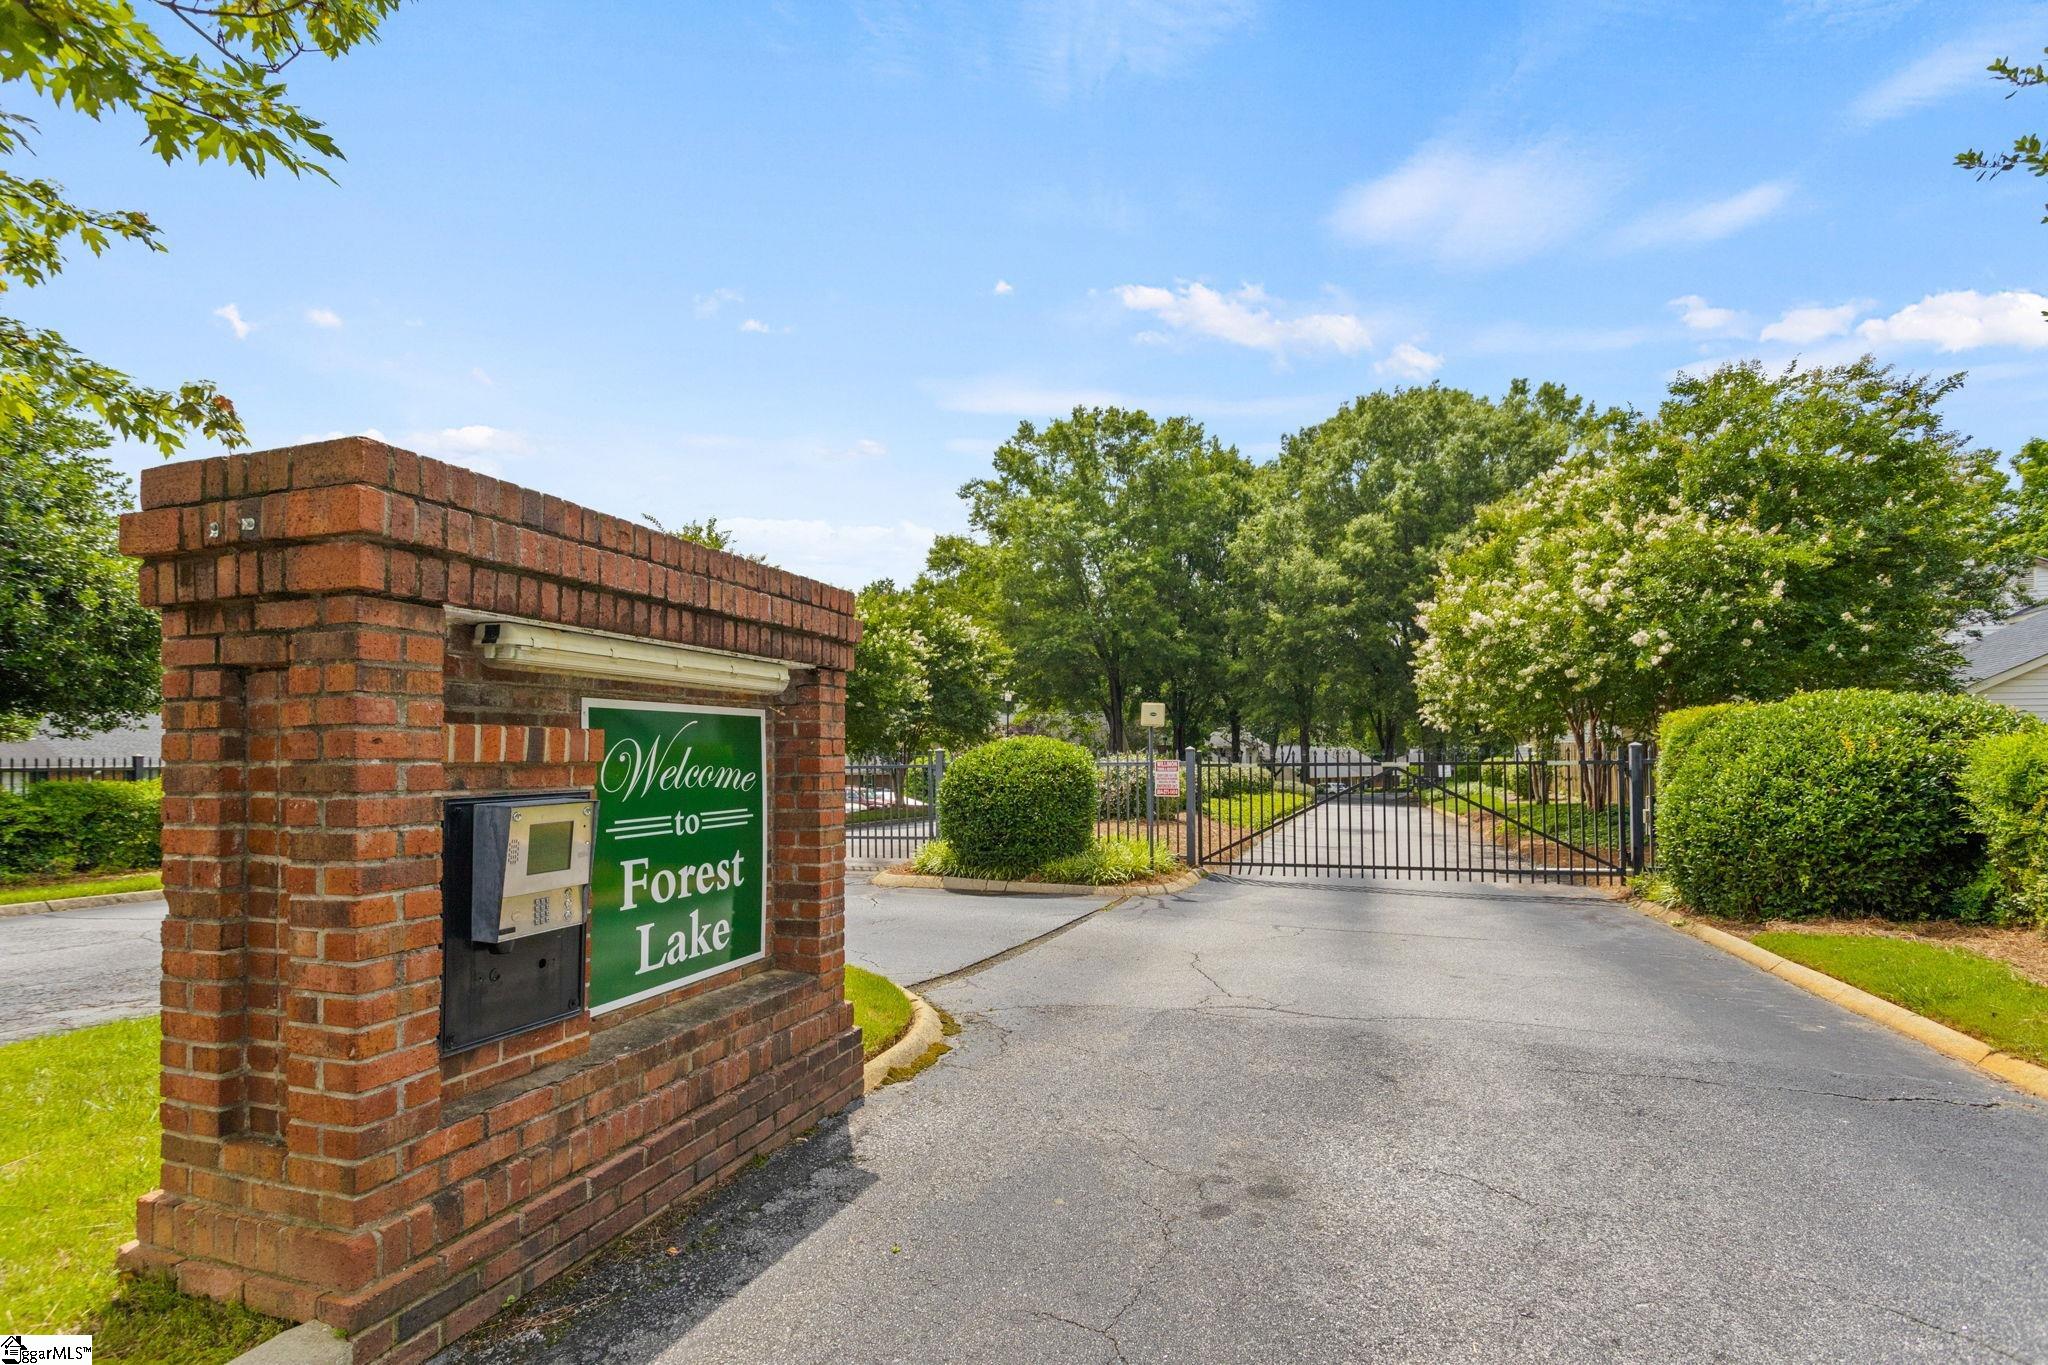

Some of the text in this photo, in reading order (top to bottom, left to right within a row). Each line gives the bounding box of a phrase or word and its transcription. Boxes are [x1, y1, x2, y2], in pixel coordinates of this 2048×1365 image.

[600, 720, 756, 802] Welcome
[674, 810, 700, 836] to
[619, 849, 745, 912] Forest
[634, 908, 731, 976] Lake
